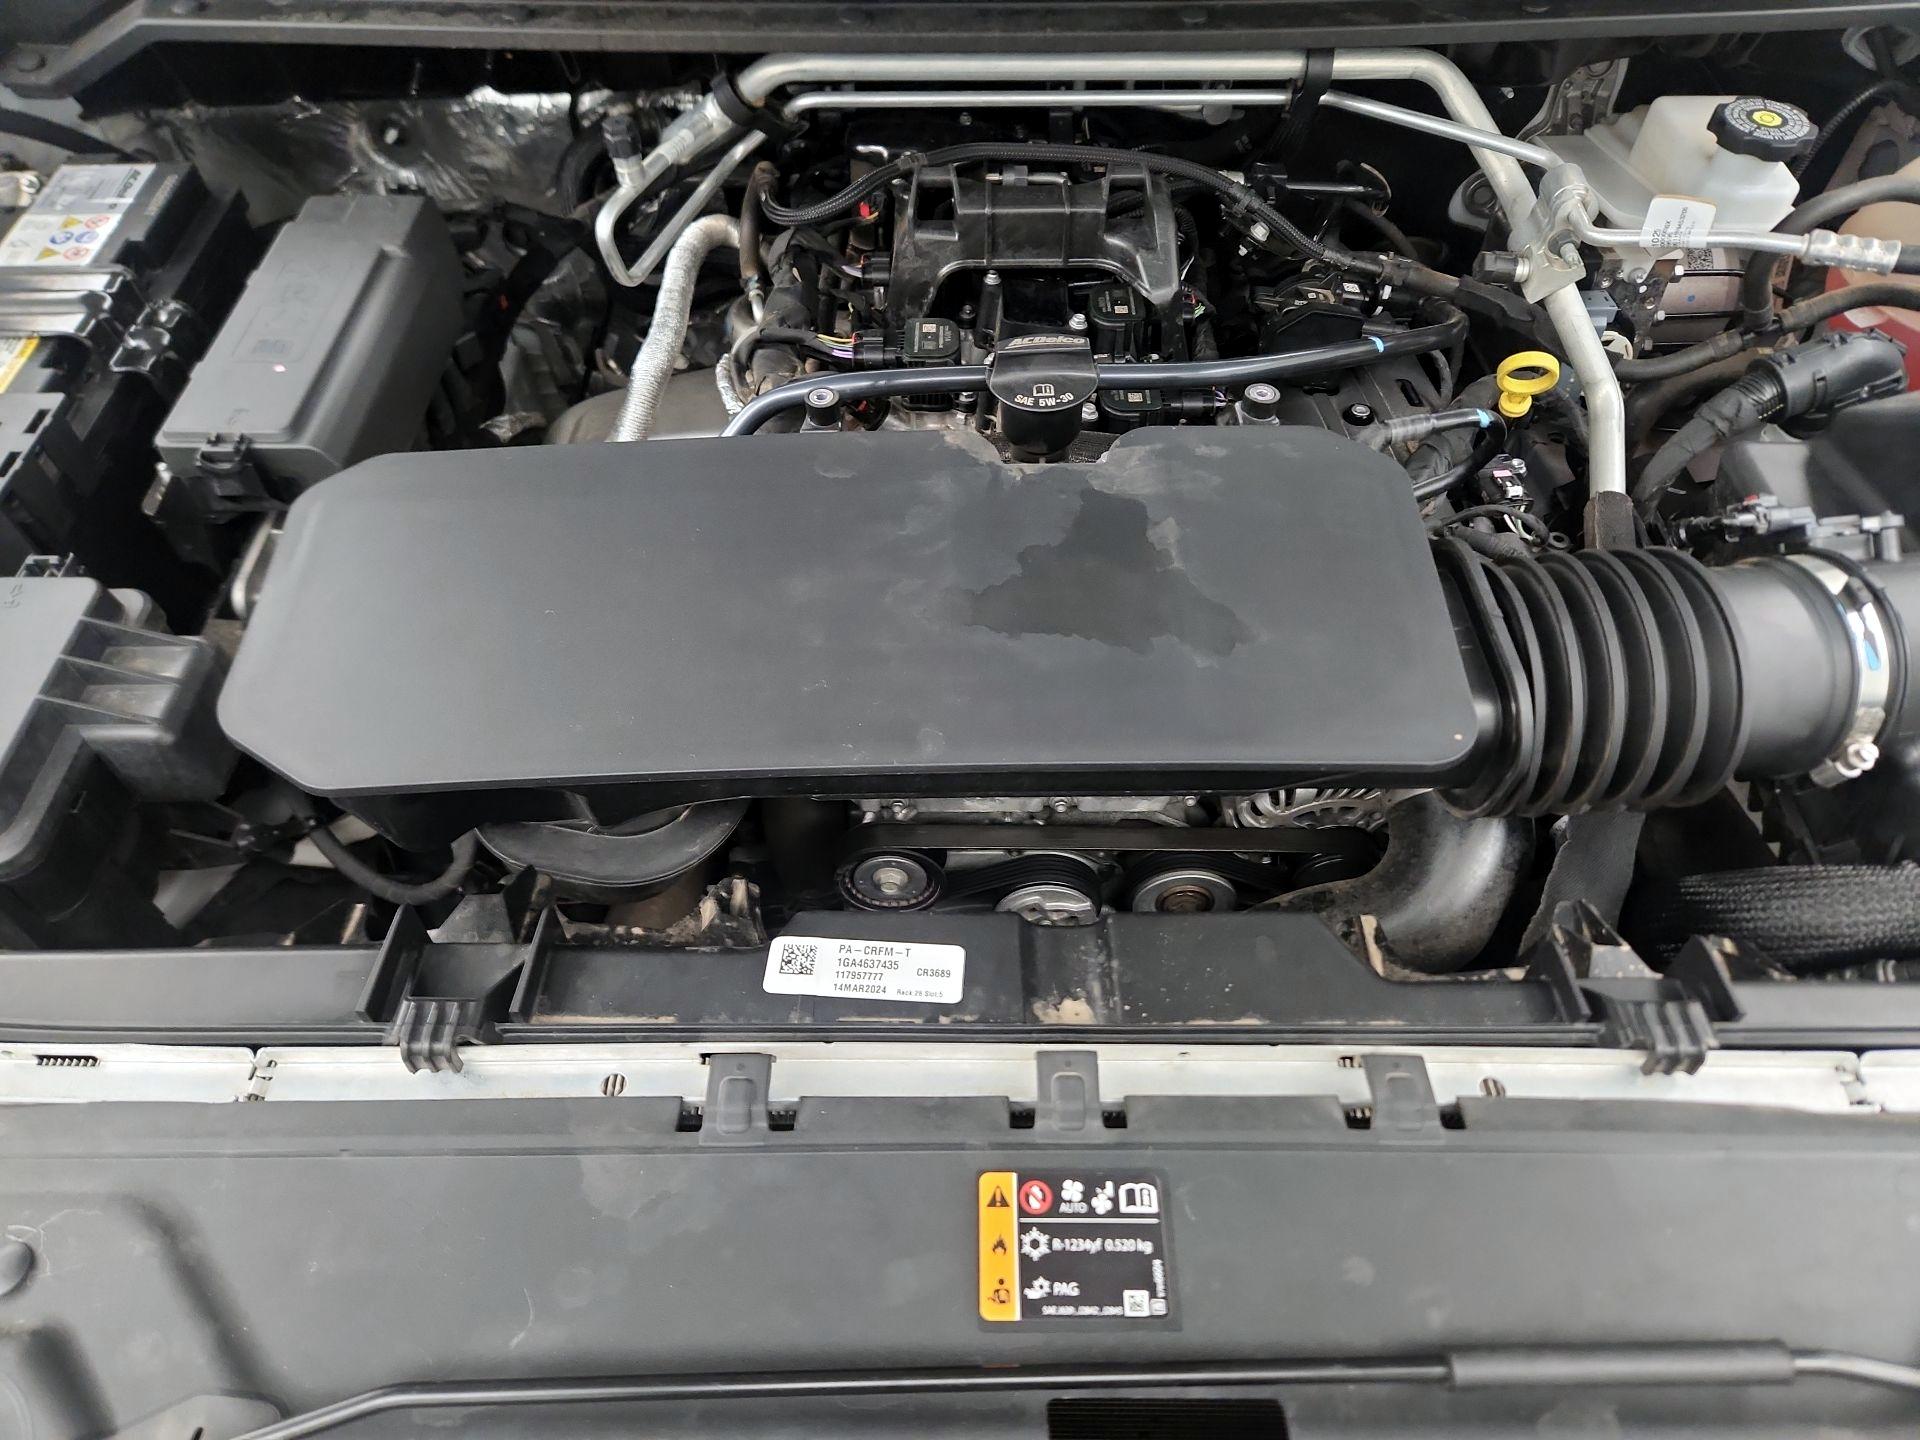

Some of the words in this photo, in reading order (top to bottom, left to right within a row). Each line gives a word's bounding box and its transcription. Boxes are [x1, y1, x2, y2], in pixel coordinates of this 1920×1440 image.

[1007, 335, 1085, 347] ACDelco
[1014, 394, 1035, 406] SAE
[1038, 392, 1074, 407] 5W-30
[837, 958, 899, 970] 1GA4637435
[835, 970, 884, 981] 117957777
[916, 968, 951, 978] CR3689
[833, 983, 887, 994] 14MAR2024
[1059, 1202, 1088, 1214] AUTO
[1052, 1238, 1103, 1254] R-1234yf
[1137, 1238, 1154, 1254] kg
[1053, 1282, 1080, 1297] PAG
